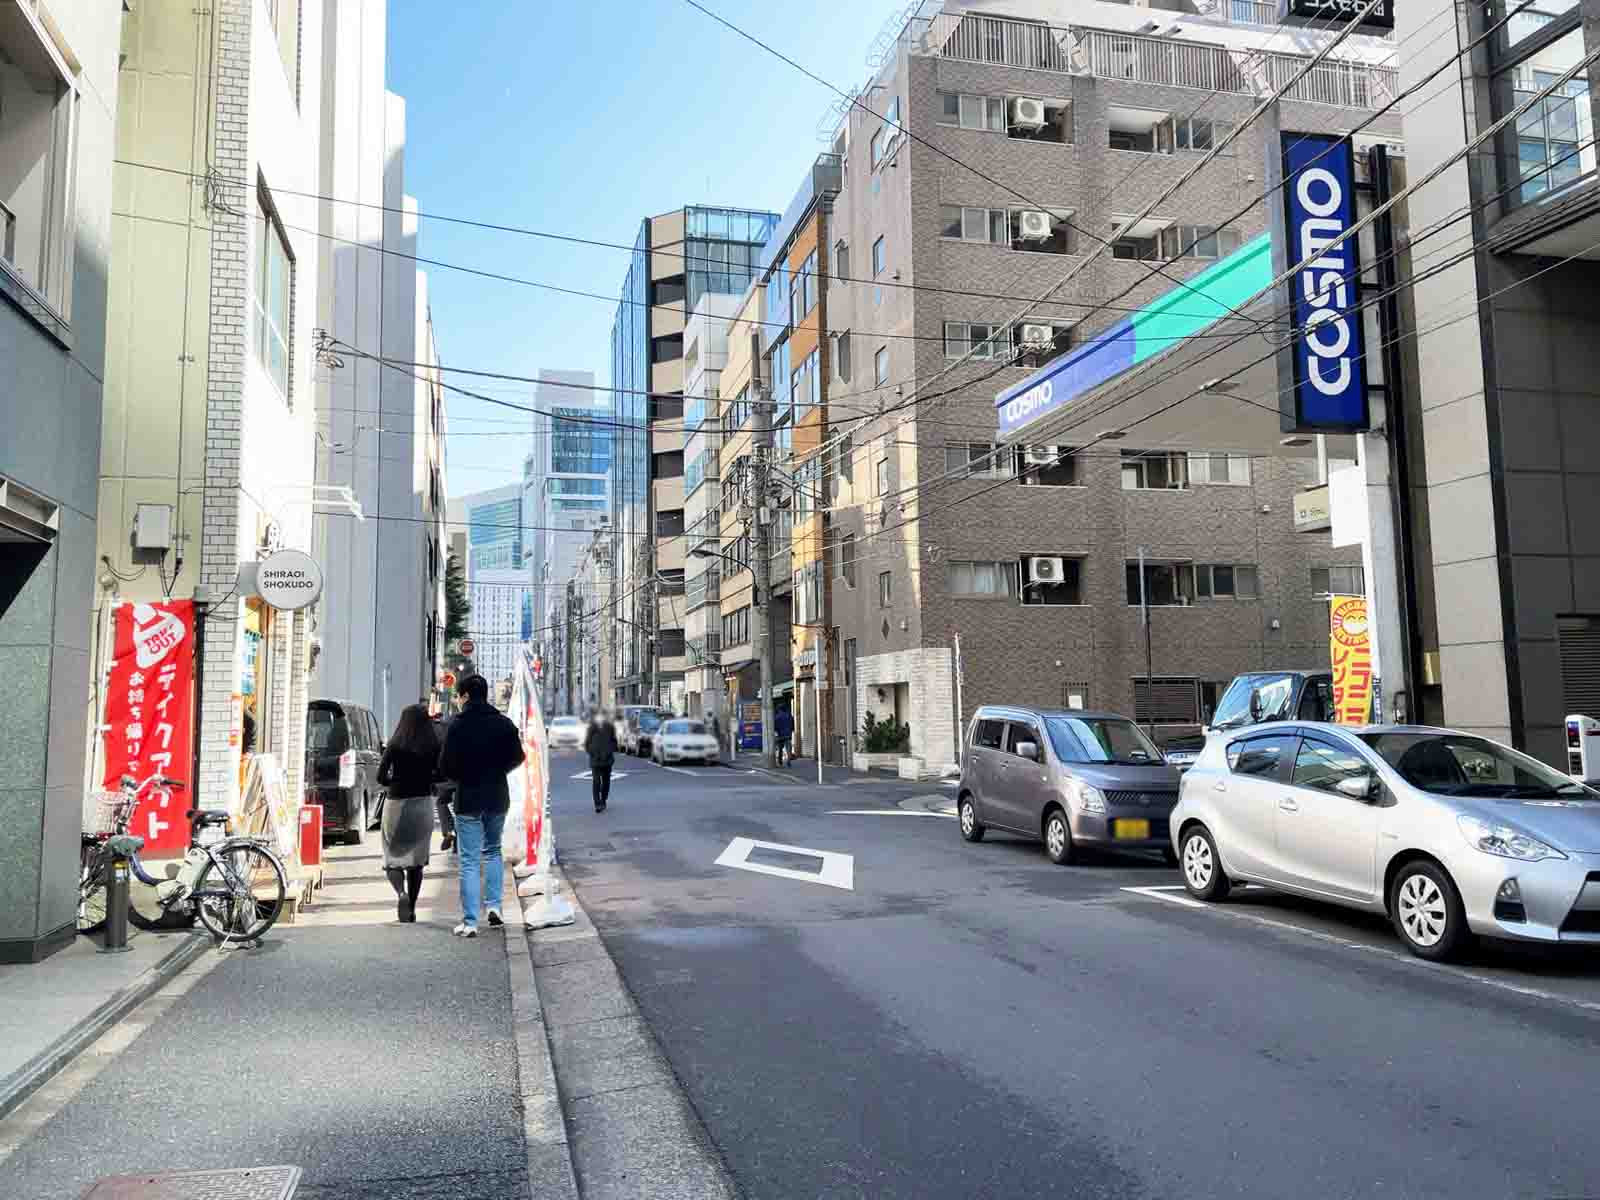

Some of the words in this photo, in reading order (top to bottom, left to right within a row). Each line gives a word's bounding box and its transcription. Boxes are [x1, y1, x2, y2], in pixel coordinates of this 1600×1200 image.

[1297, 168, 1351, 395] COSMO
[264, 570, 305, 578] SHIRAOI
[264, 580, 314, 589] SHOKUDO
[150, 631, 177, 655] OUT
